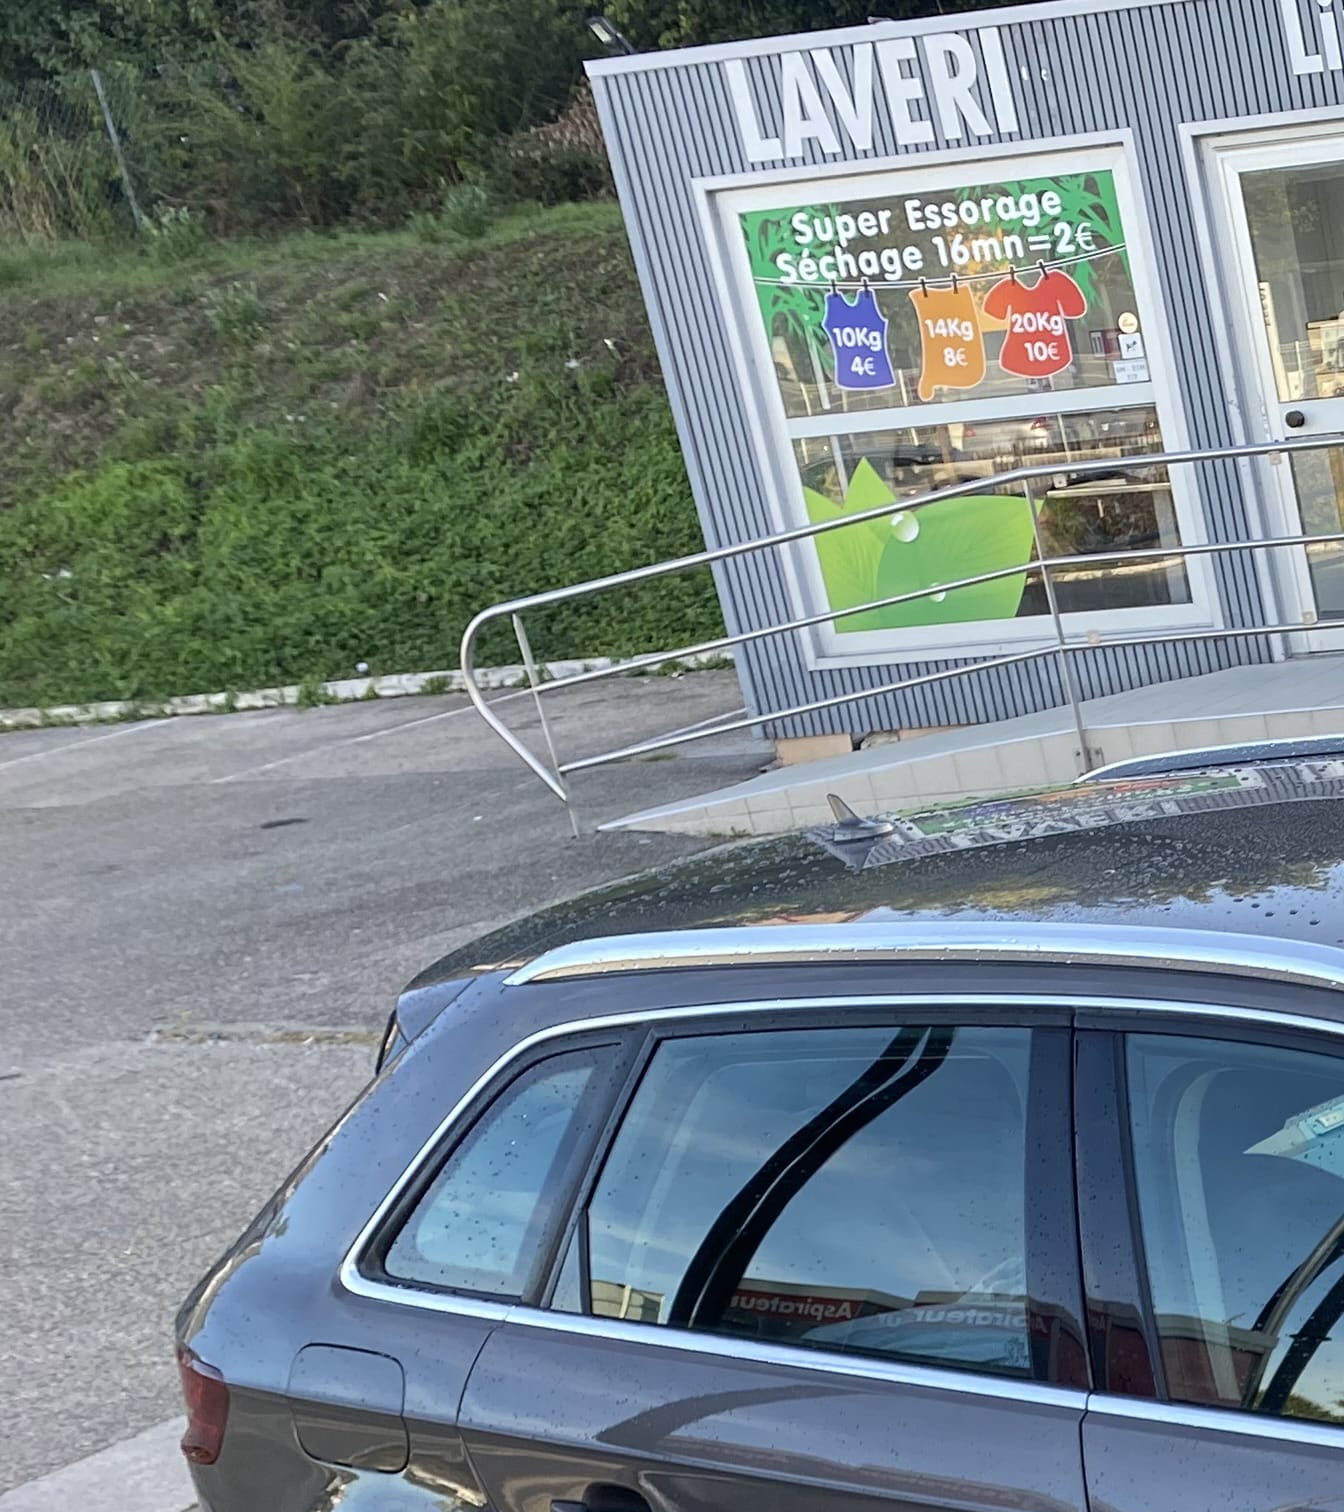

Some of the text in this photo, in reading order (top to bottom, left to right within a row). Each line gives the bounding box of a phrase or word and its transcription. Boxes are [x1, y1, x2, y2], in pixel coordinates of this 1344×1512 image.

[724, 26, 1019, 163] LAVERI
[791, 189, 1063, 247] Super Essorage
[775, 244, 923, 283] Séchage
[924, 317, 974, 341] 14Kg
[1011, 311, 1064, 336] 20Kg
[832, 326, 882, 352] 10Kg
[1024, 341, 1060, 362] 10€
[850, 356, 876, 376] 4€
[943, 346, 969, 367] 8€
